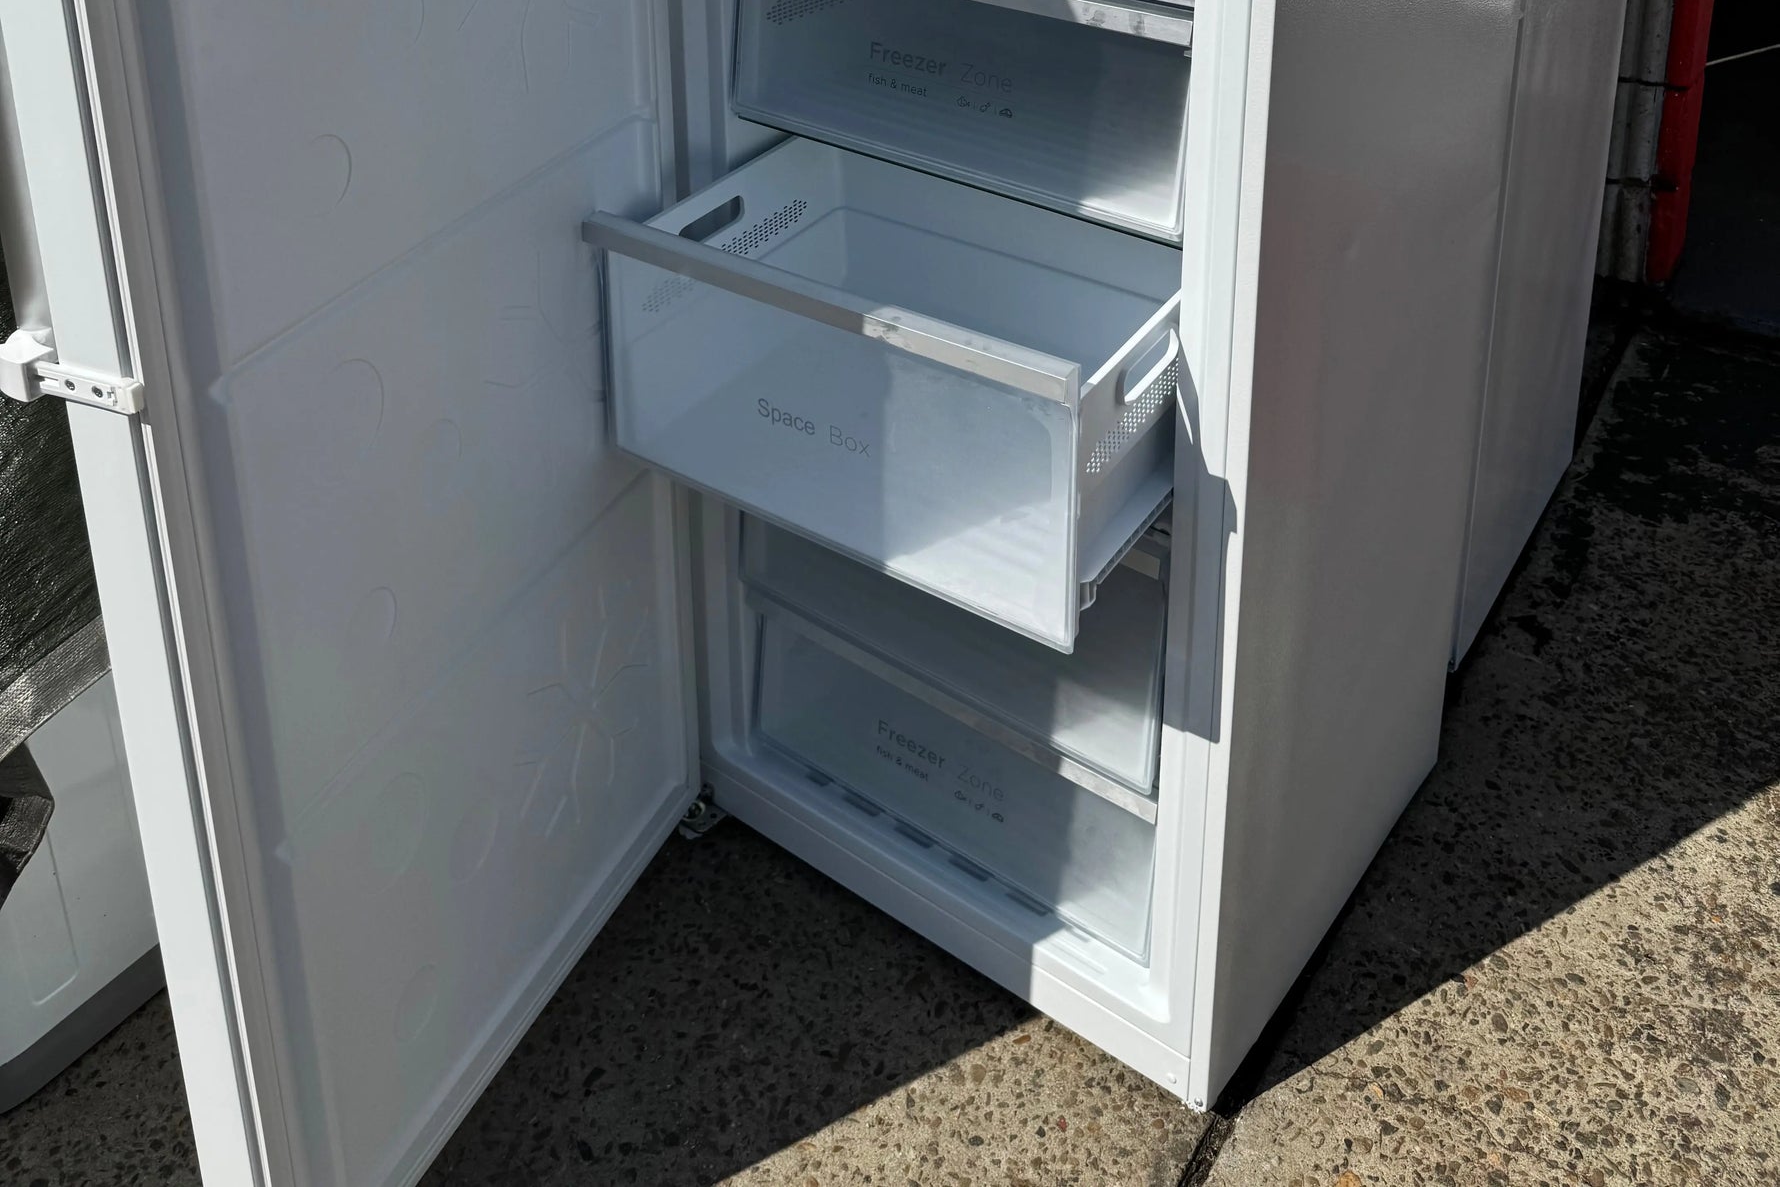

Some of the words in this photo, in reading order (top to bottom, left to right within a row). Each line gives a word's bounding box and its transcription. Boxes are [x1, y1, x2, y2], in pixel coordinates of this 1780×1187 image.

[868, 72, 887, 87] fish
[890, 78, 897, 90] &
[901, 82, 928, 98] meat
[869, 41, 948, 76] Freezer
[960, 64, 1013, 94] Zone
[757, 397, 816, 436] Space
[829, 424, 871, 458] Box
[876, 745, 893, 761] fish
[895, 756, 903, 767] &
[905, 762, 929, 782] meat
[877, 719, 946, 769] Freezer
[957, 765, 1005, 802] Zone
